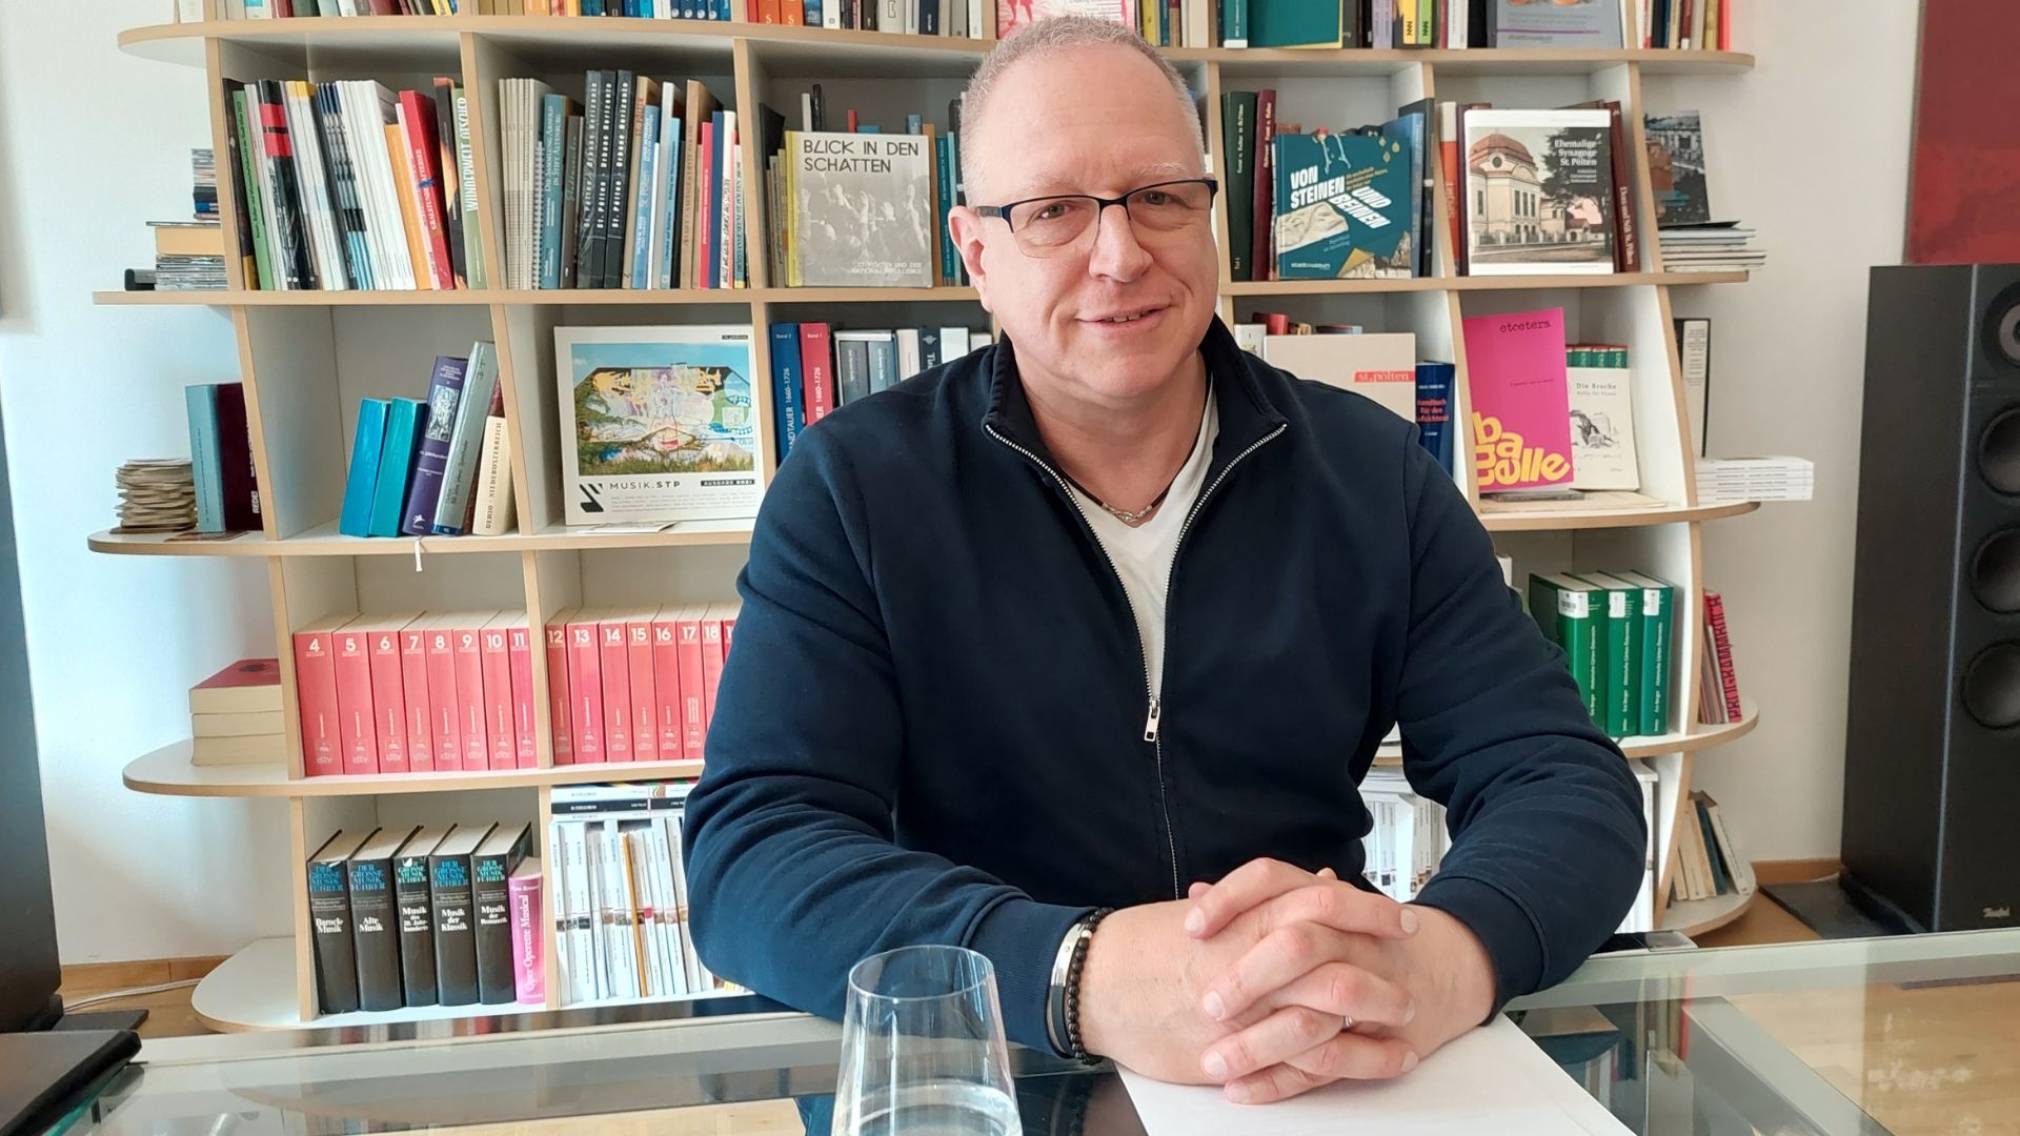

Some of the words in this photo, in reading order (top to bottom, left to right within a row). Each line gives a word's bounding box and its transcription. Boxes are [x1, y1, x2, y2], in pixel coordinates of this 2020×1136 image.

[804, 139, 854, 154] BLICK
[864, 141, 878, 154] IN
[887, 141, 919, 156] DEN
[1554, 139, 1597, 149] Ehemalige
[1558, 149, 1597, 159] Synagoge
[804, 157, 892, 173] SCHATTEN
[1560, 158, 1570, 166] St.
[1571, 158, 1597, 166] Pölten
[1290, 165, 1318, 190] VON
[1290, 175, 1345, 210] STEINEN
[1351, 186, 1392, 208] UND
[1328, 193, 1392, 229] BEINEN
[548, 629, 563, 643] 12
[574, 629, 590, 643] 13
[605, 628, 621, 642] 14
[631, 627, 647, 641] 15
[655, 627, 672, 641] 16
[683, 626, 696, 640] 17
[704, 625, 719, 639] 18
[309, 638, 320, 652] 4
[345, 638, 356, 652] 5
[379, 636, 391, 650] 6
[409, 636, 419, 649] 7
[435, 635, 445, 649] 8
[462, 634, 472, 648] 9
[486, 634, 502, 648] 10
[513, 633, 525, 647] 11
[402, 906, 427, 916] Musik
[441, 908, 465, 917] Musik
[481, 904, 505, 913] Musik
[517, 894, 529, 928] Musical
[363, 916, 379, 924] Alte
[441, 922, 468, 932] Klassik
[359, 923, 384, 933] Musik
[520, 928, 533, 968] Operette
